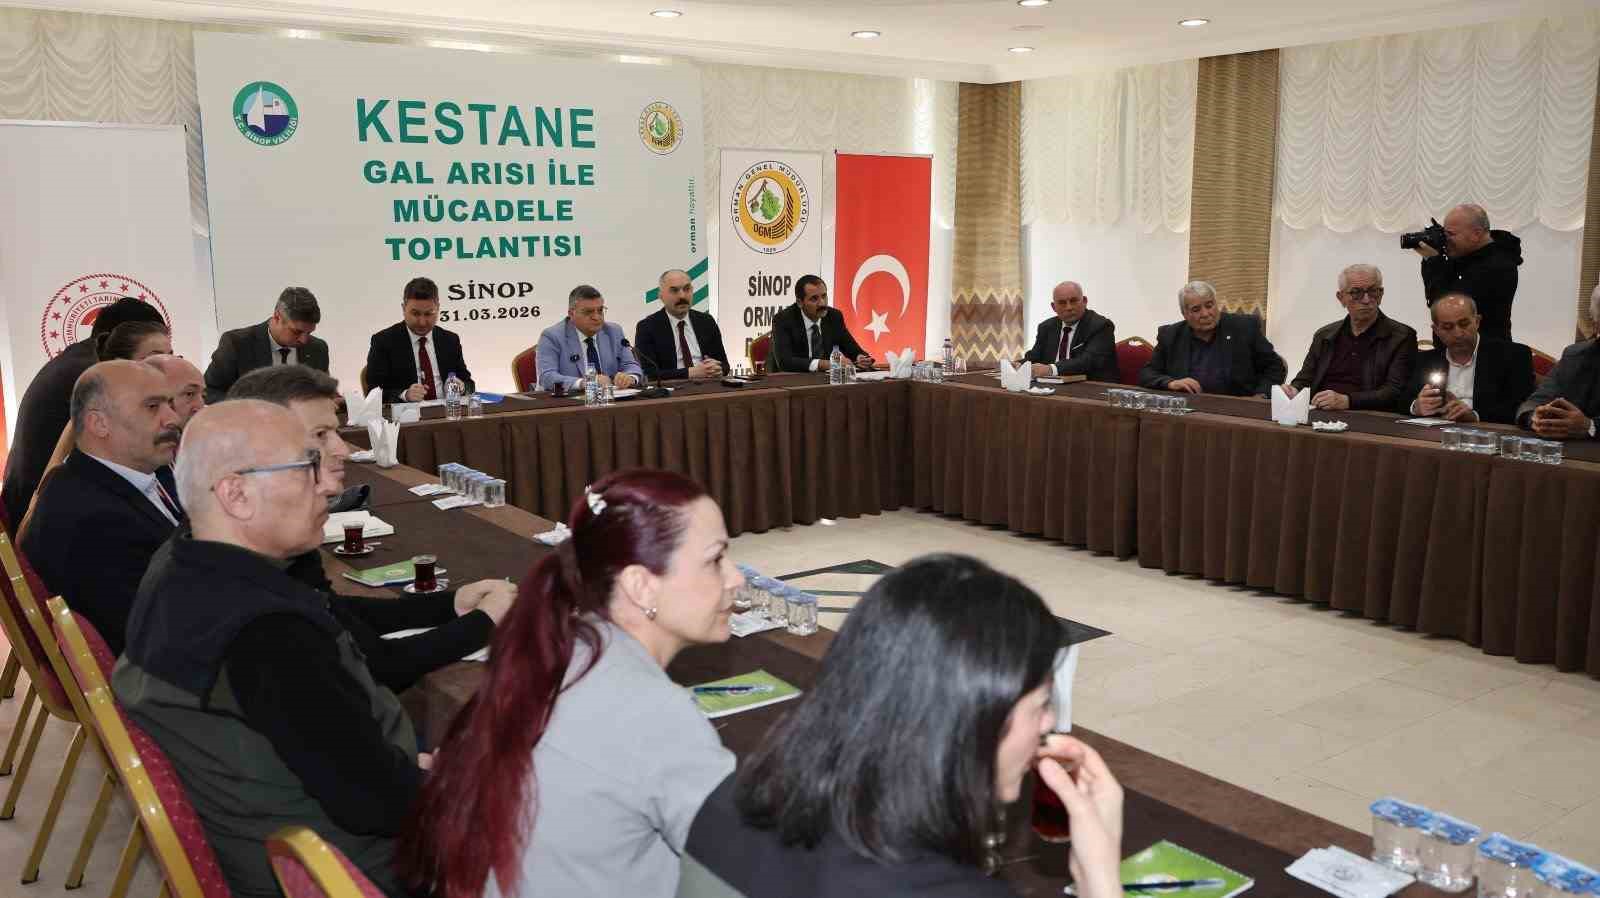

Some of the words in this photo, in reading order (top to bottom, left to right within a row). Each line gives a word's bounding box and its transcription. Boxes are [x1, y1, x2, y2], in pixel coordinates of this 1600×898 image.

[356, 98, 596, 149] KESTANE
[362, 159, 433, 185] GAL
[447, 160, 535, 186] ARISI
[548, 157, 594, 186] İLE
[393, 195, 575, 223] MÜCADELE
[753, 223, 772, 239] OGM
[385, 234, 582, 261] TOPLANTISI
[447, 279, 534, 301] SİNOP
[747, 270, 792, 297] SİNOP
[440, 306, 541, 322] 31.03.2026
